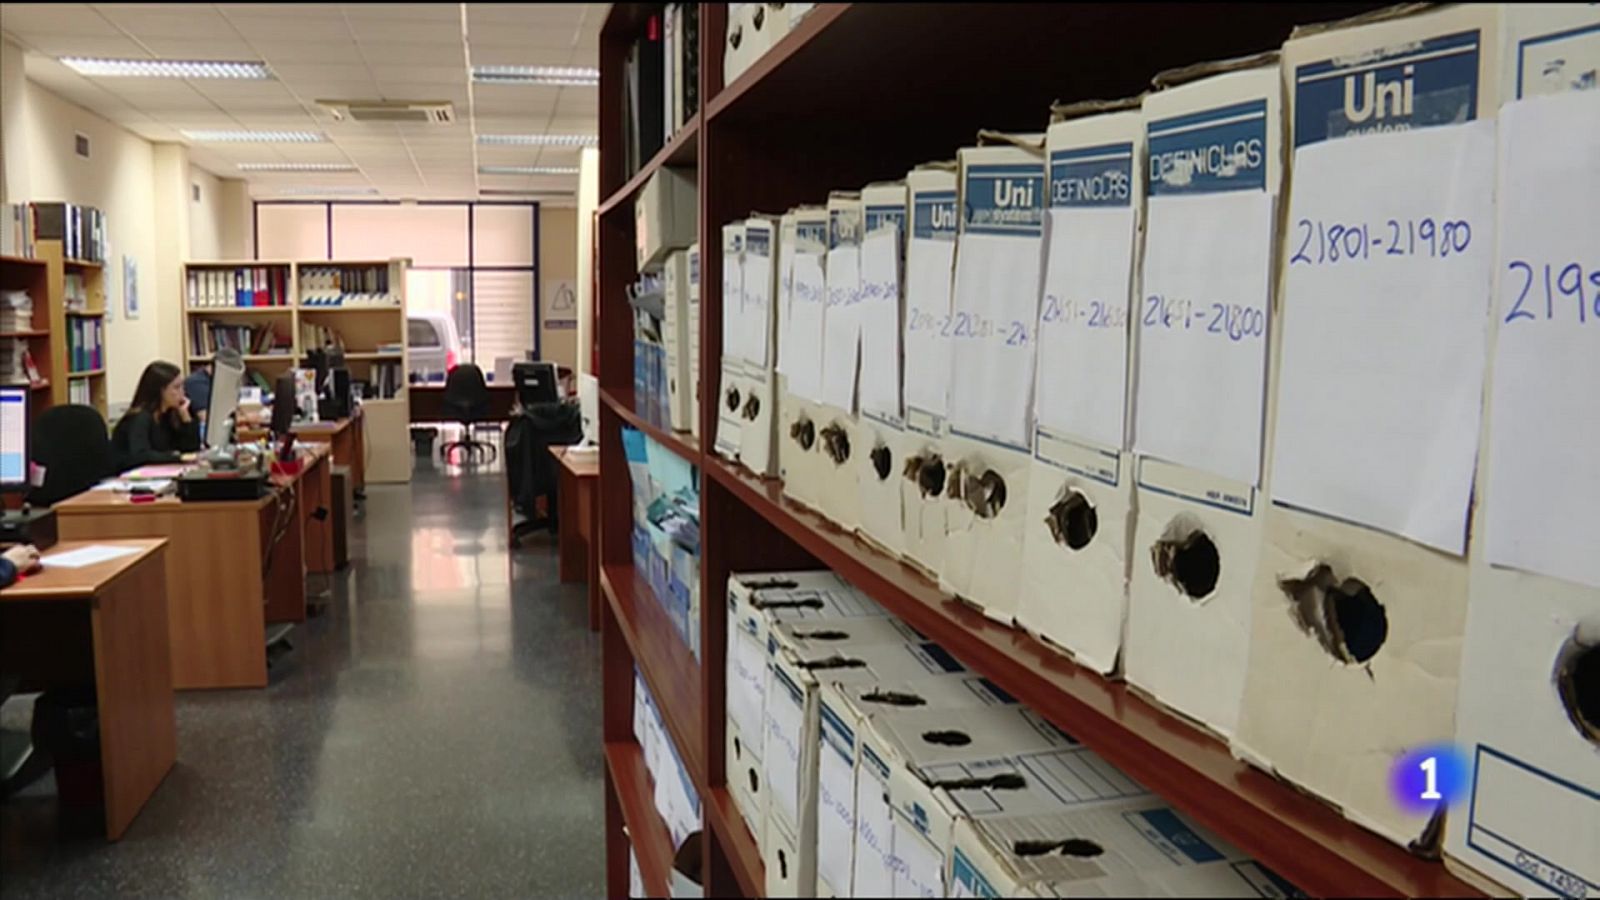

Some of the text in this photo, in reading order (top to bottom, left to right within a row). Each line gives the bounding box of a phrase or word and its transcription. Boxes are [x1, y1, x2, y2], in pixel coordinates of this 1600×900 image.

[1344, 64, 1415, 124] Uni
[994, 178, 1034, 207] Uni
[1290, 217, 1472, 264] 21801-21980
